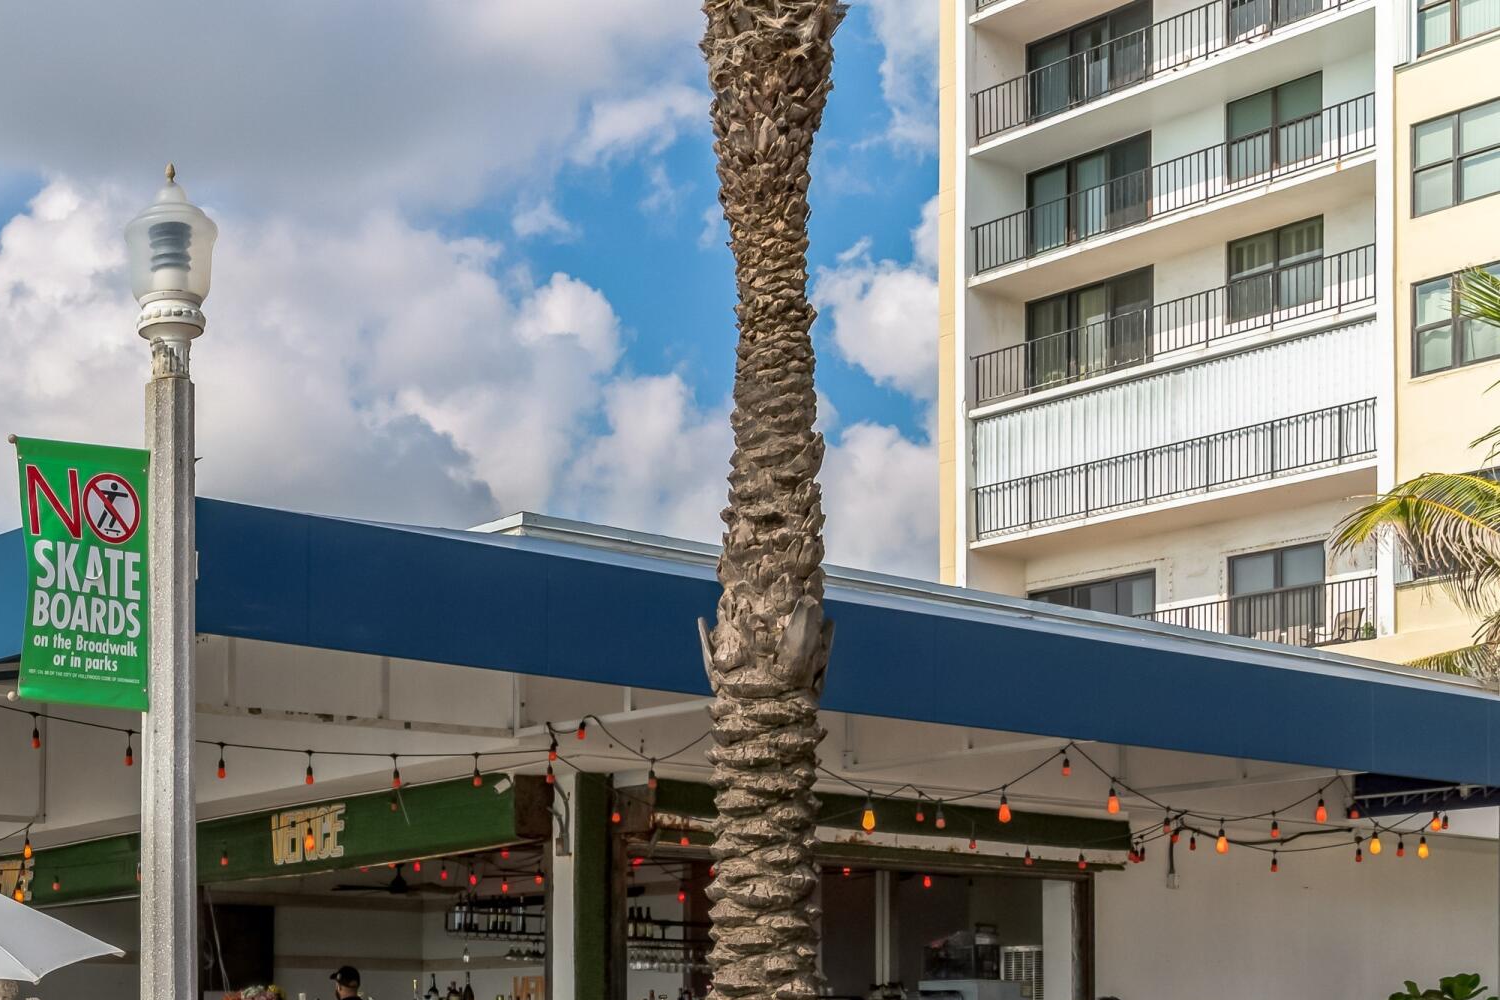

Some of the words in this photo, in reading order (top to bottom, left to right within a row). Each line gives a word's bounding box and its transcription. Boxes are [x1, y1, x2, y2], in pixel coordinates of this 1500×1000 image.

[34, 539, 141, 600] SKATE
[32, 590, 141, 638] BOARDS
[33, 634, 49, 647] on
[53, 633, 72, 650] the
[76, 634, 138, 657] Broadwalk
[53, 654, 67, 666] or
[70, 651, 81, 668] in
[85, 655, 118, 672] parks
